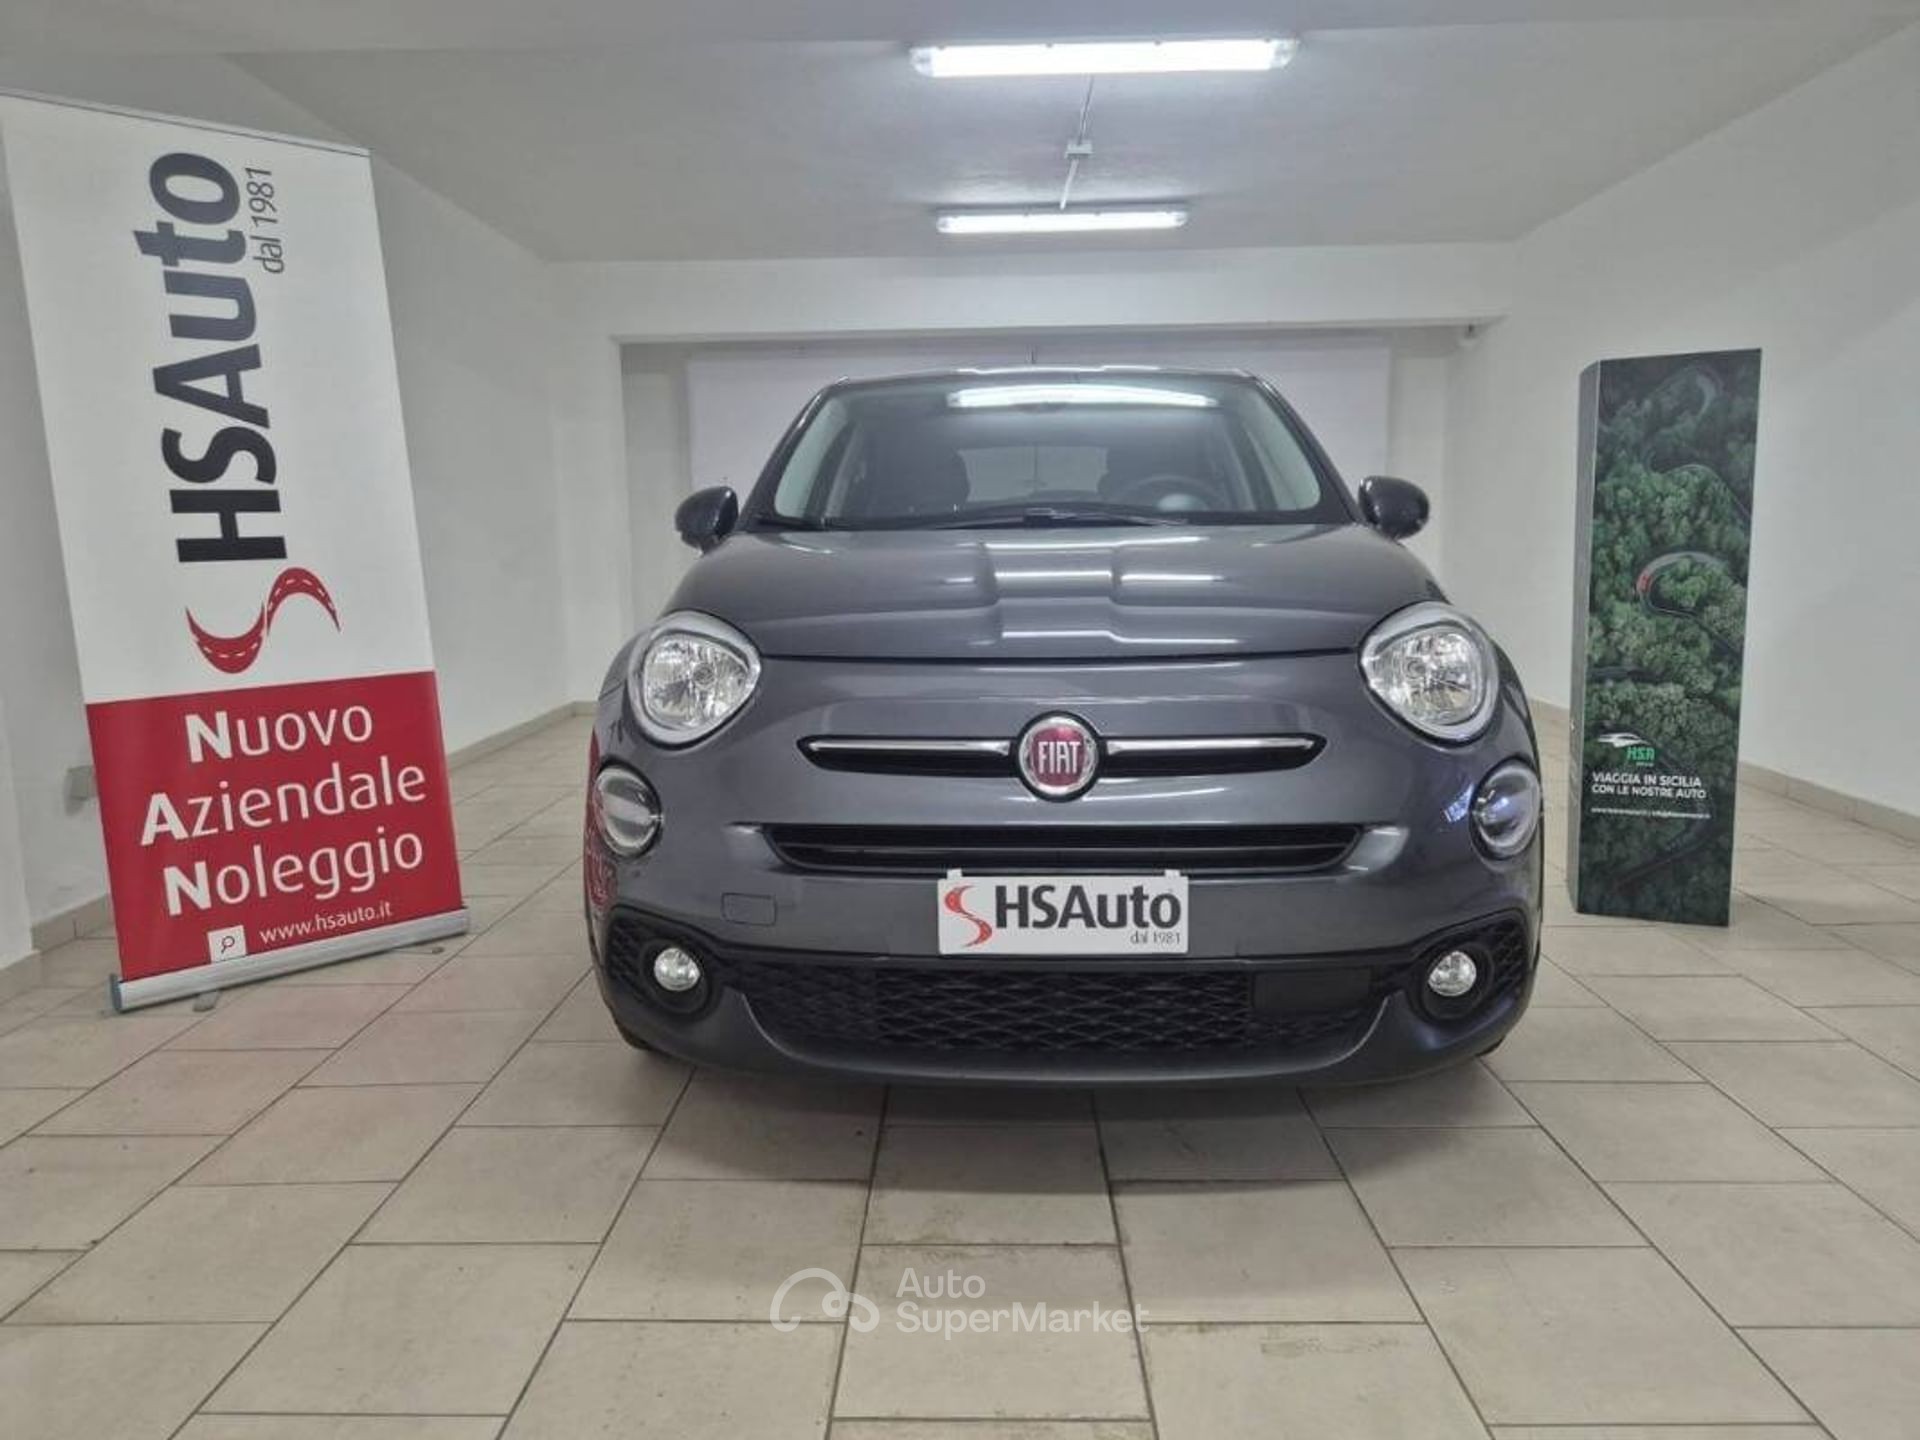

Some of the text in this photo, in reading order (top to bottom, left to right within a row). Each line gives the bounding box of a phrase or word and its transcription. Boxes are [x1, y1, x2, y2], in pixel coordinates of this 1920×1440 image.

[243, 166, 284, 274] dal 1981
[132, 152, 287, 563] HSAuto
[184, 705, 373, 763] Nuovo
[1037, 741, 1081, 774] FIAT
[1592, 772, 1702, 787] VIAGGIA IN SICILIA
[140, 755, 426, 846] Aziendale
[1592, 785, 1707, 799] CON LE NOSTRE AUTO
[163, 826, 423, 917] Noleggio
[259, 902, 392, 944] www.hsauto.it
[995, 885, 1181, 929] HSAuto
[1130, 931, 1180, 944] dal 1981
